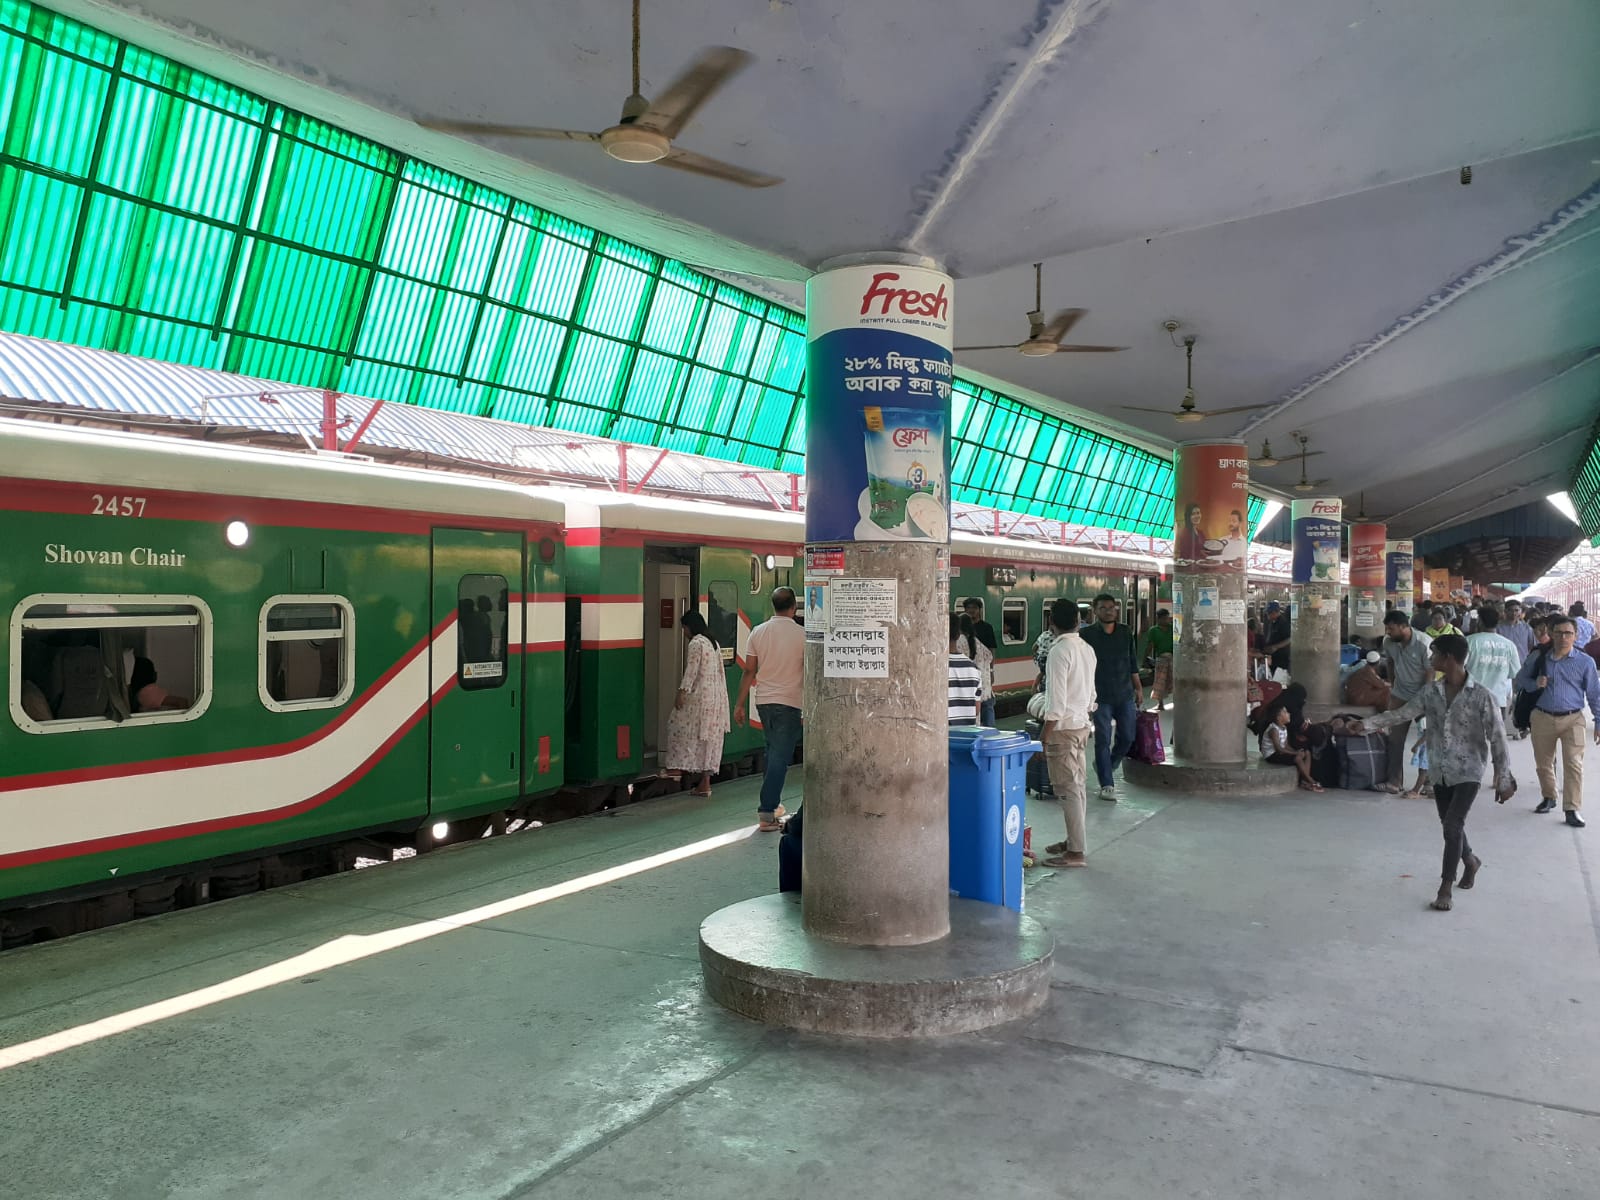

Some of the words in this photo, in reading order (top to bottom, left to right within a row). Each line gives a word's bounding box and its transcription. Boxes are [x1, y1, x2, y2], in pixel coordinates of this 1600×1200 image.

[860, 272, 947, 321] Fresh
[844, 357, 882, 371] ২৮%
[886, 351, 920, 375] মিল্ক
[844, 375, 902, 392] অবাক
[908, 377, 933, 392] করা
[91, 494, 146, 517] 2457
[1311, 500, 1340, 513] Fresh
[44, 543, 123, 565] Shovan
[129, 547, 186, 567] Chair
